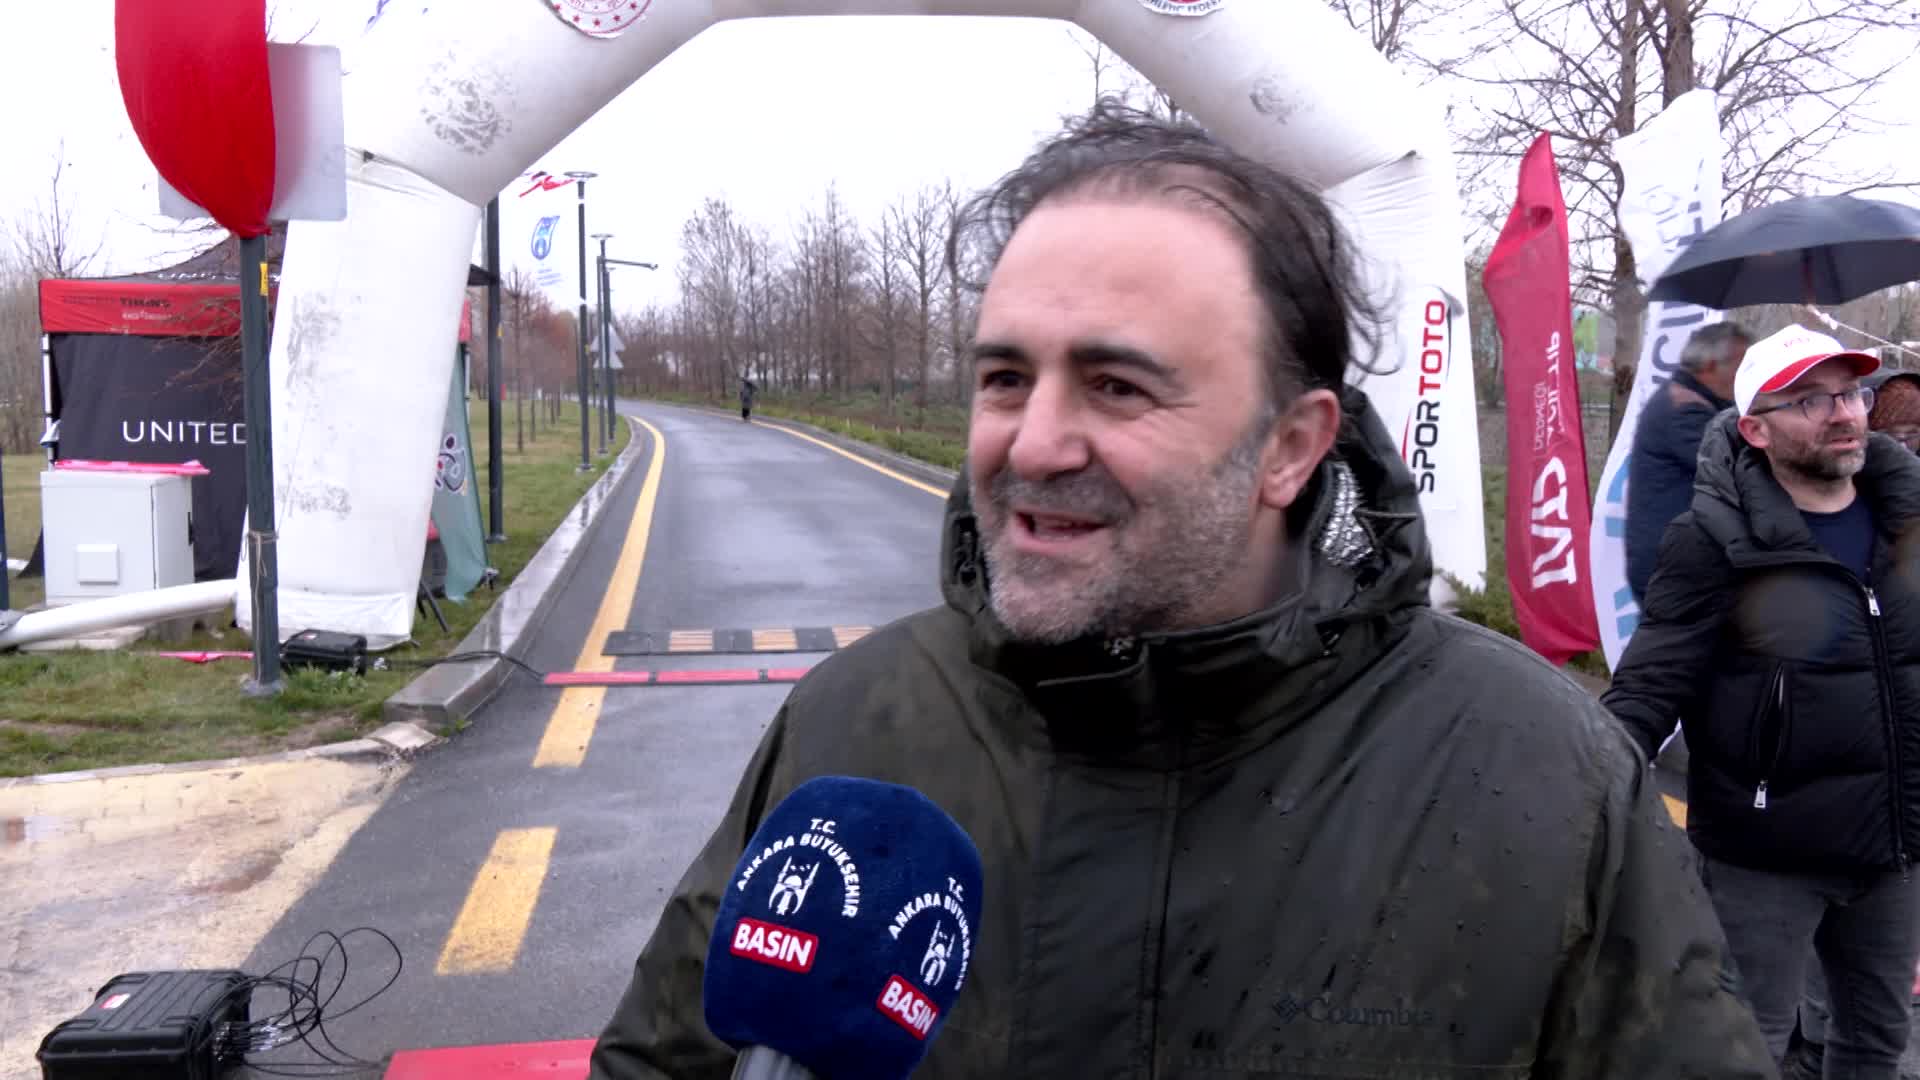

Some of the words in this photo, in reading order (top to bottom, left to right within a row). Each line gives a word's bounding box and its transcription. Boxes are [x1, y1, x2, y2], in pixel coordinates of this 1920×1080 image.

[737, 835, 795, 891] ANKARA
[888, 892, 941, 940] ANKARA
[733, 923, 812, 966] BASIN
[881, 980, 937, 1035] BASIN
